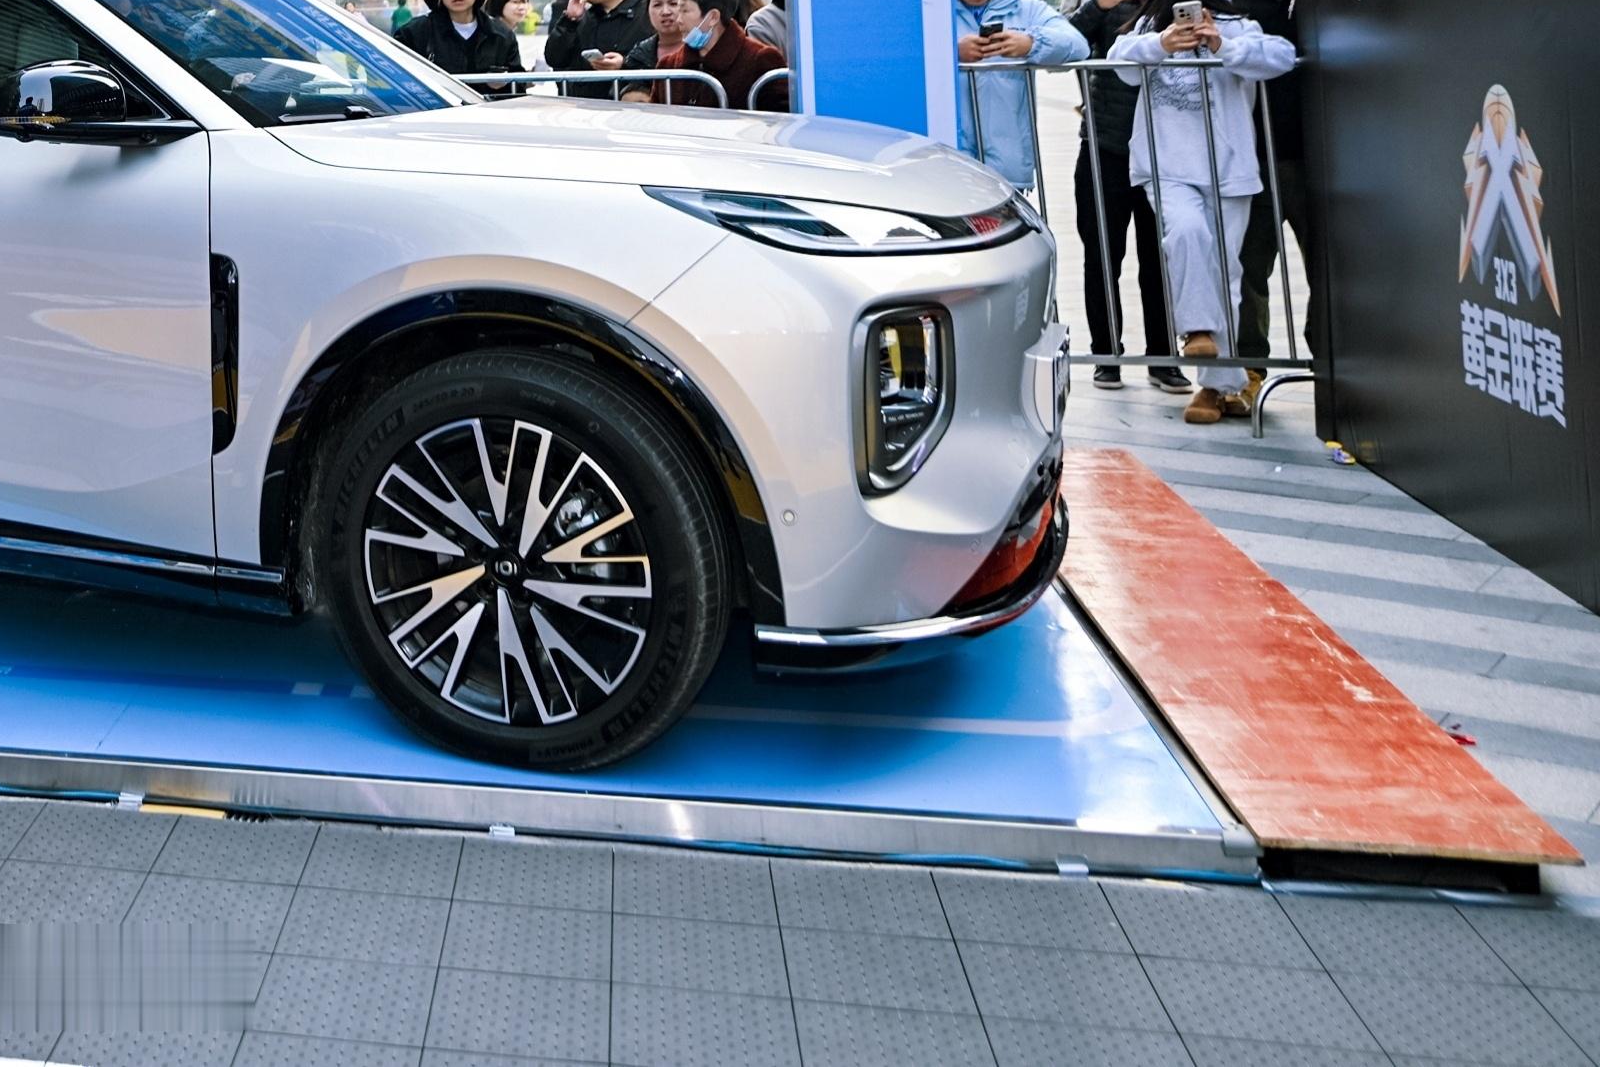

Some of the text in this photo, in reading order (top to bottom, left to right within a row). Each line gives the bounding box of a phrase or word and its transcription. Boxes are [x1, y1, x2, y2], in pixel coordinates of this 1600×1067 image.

[1494, 256, 1518, 306] 3X3
[1460, 300, 1567, 429] 黄金联赛
